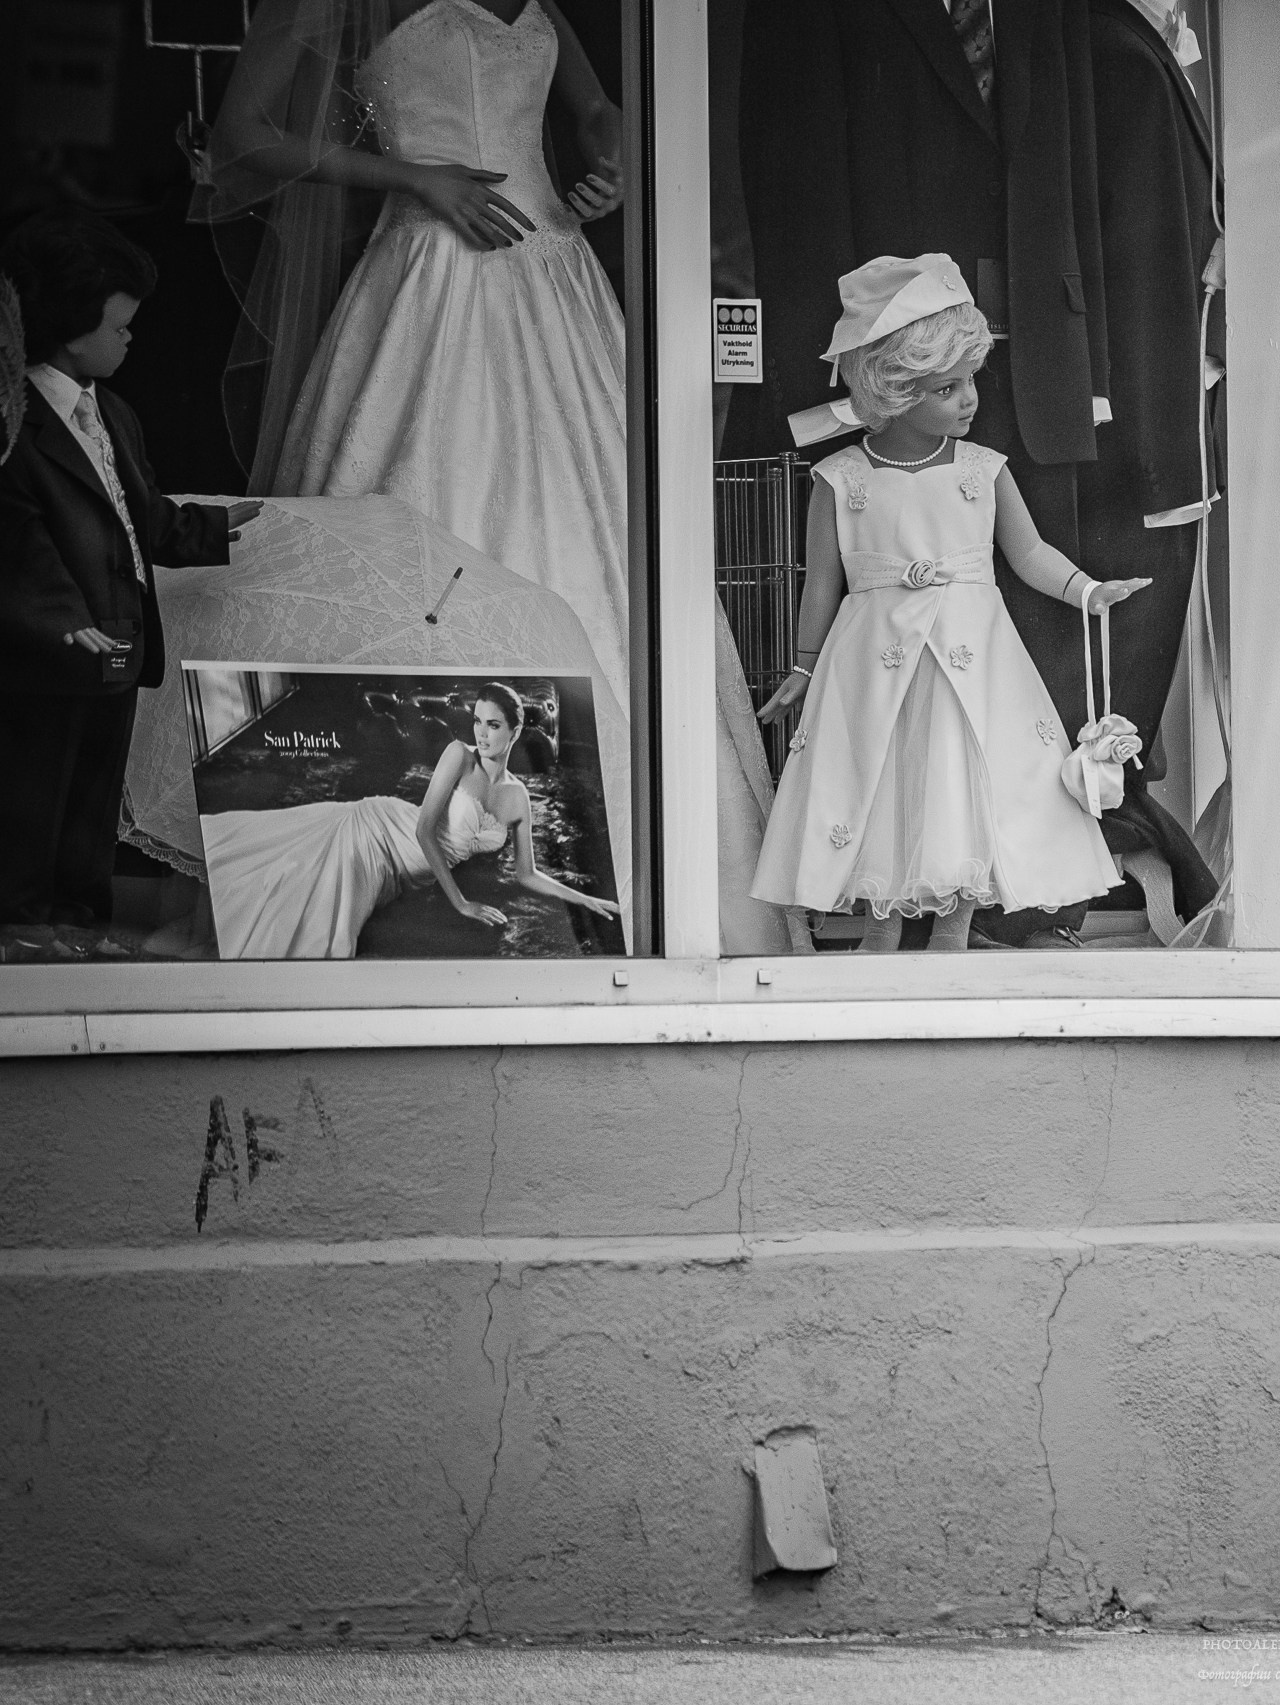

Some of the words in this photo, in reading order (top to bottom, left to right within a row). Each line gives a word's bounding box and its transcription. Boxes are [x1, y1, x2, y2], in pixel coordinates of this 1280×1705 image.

[718, 324, 757, 333] SECURITAS
[721, 359, 755, 367] Utrykning
[264, 730, 290, 747] San
[293, 731, 341, 749] Patrick
